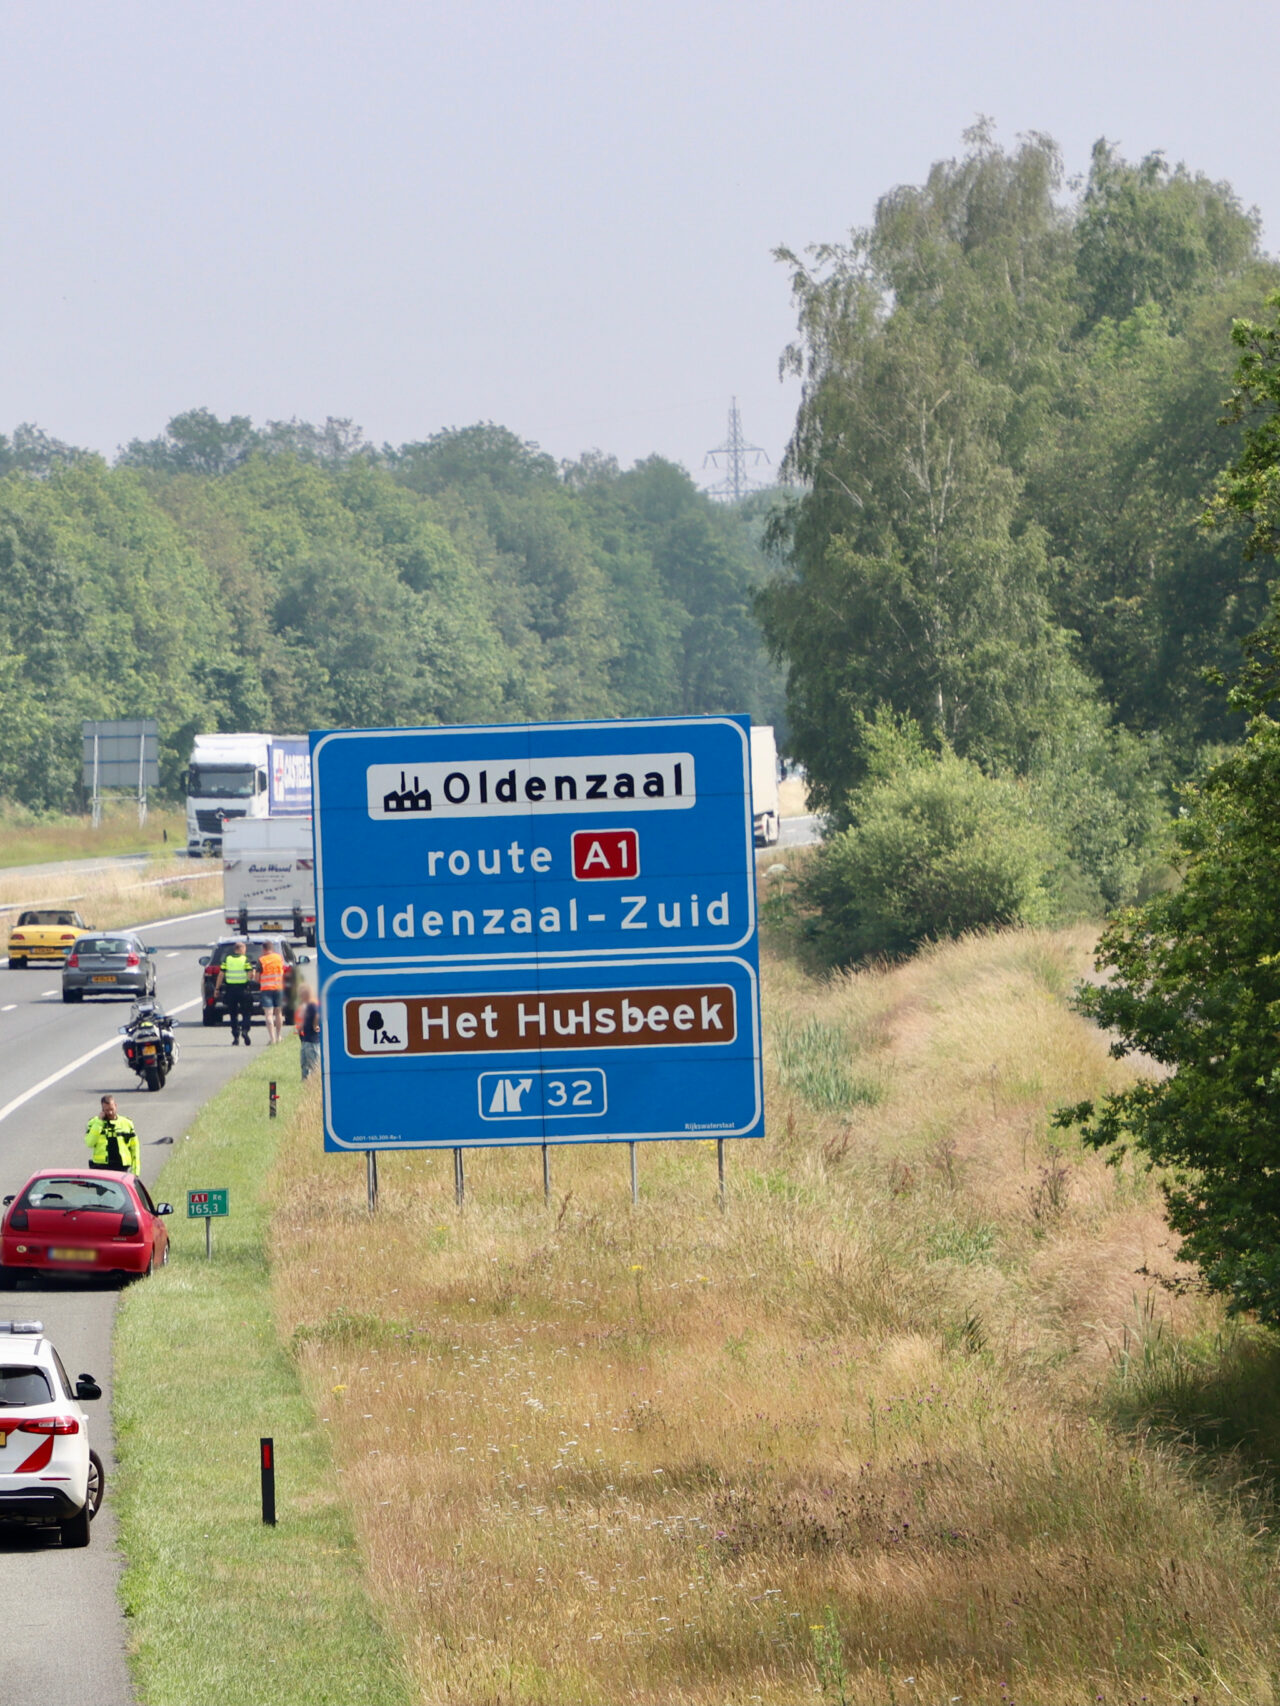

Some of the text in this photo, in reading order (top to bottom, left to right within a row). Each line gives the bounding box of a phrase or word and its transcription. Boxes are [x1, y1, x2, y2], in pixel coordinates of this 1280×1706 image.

[443, 762, 683, 804] Oldenzaal
[428, 839, 629, 876] route A1
[421, 994, 724, 1040] Het Hulsbeek
[547, 1080, 593, 1107] 32
[684, 1122, 735, 1131] Rijkswaterstaat
[193, 1193, 223, 1203] A1 Re
